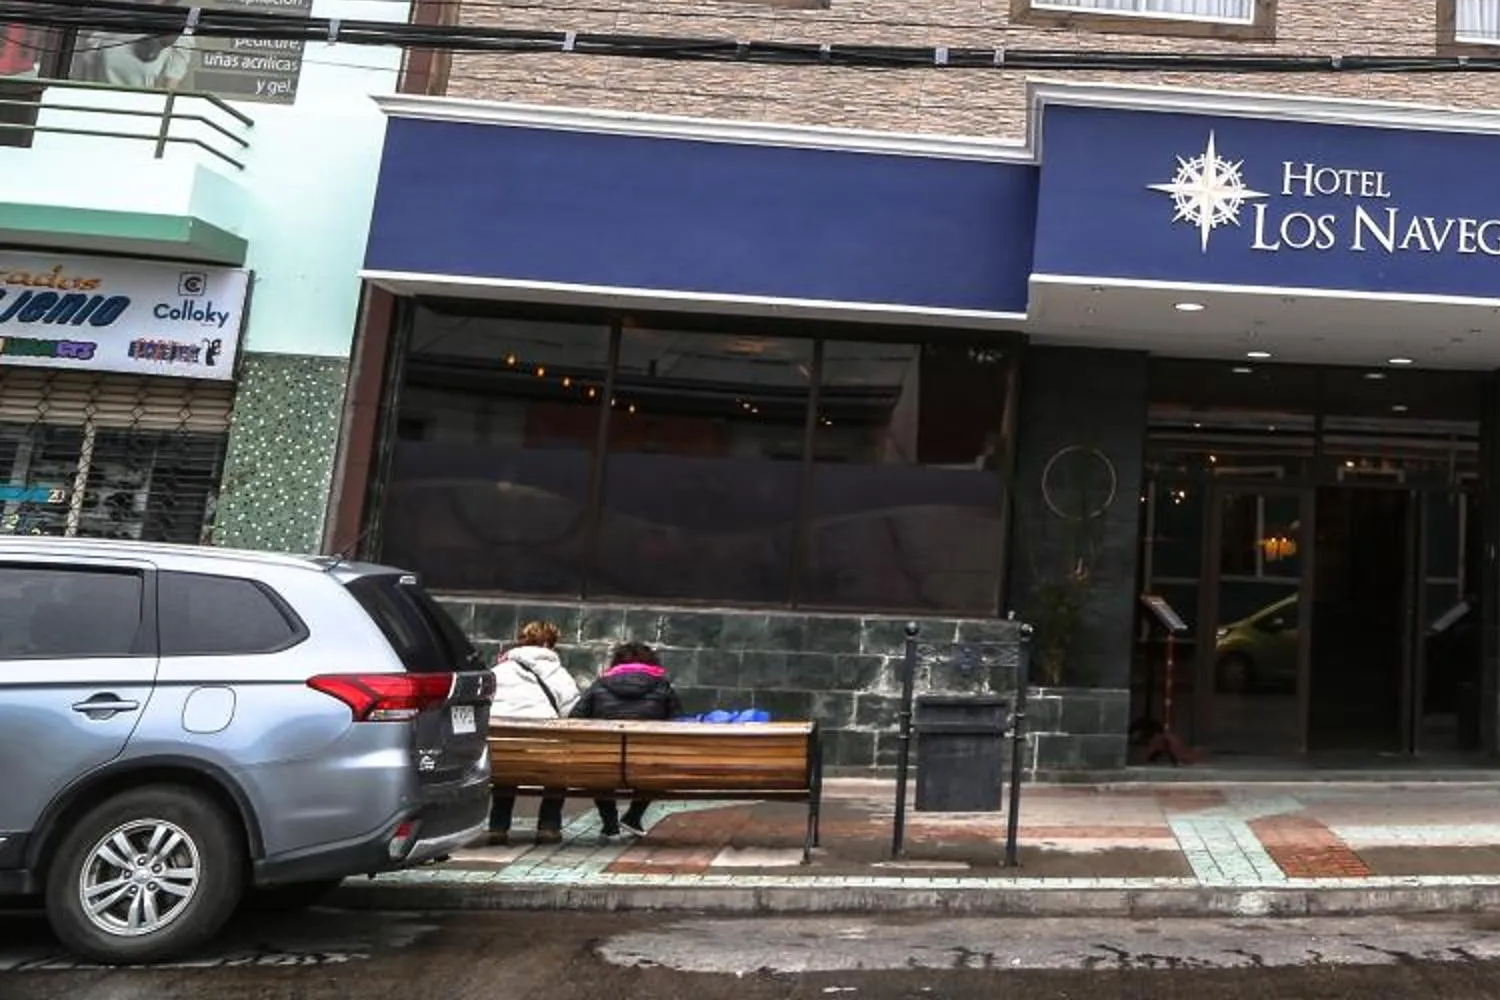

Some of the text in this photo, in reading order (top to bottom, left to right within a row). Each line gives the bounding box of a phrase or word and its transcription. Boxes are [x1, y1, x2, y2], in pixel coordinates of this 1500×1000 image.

[1281, 161, 1391, 199] HOTEL
[1250, 203, 1335, 251] LOS
[153, 299, 230, 328] Colloky
